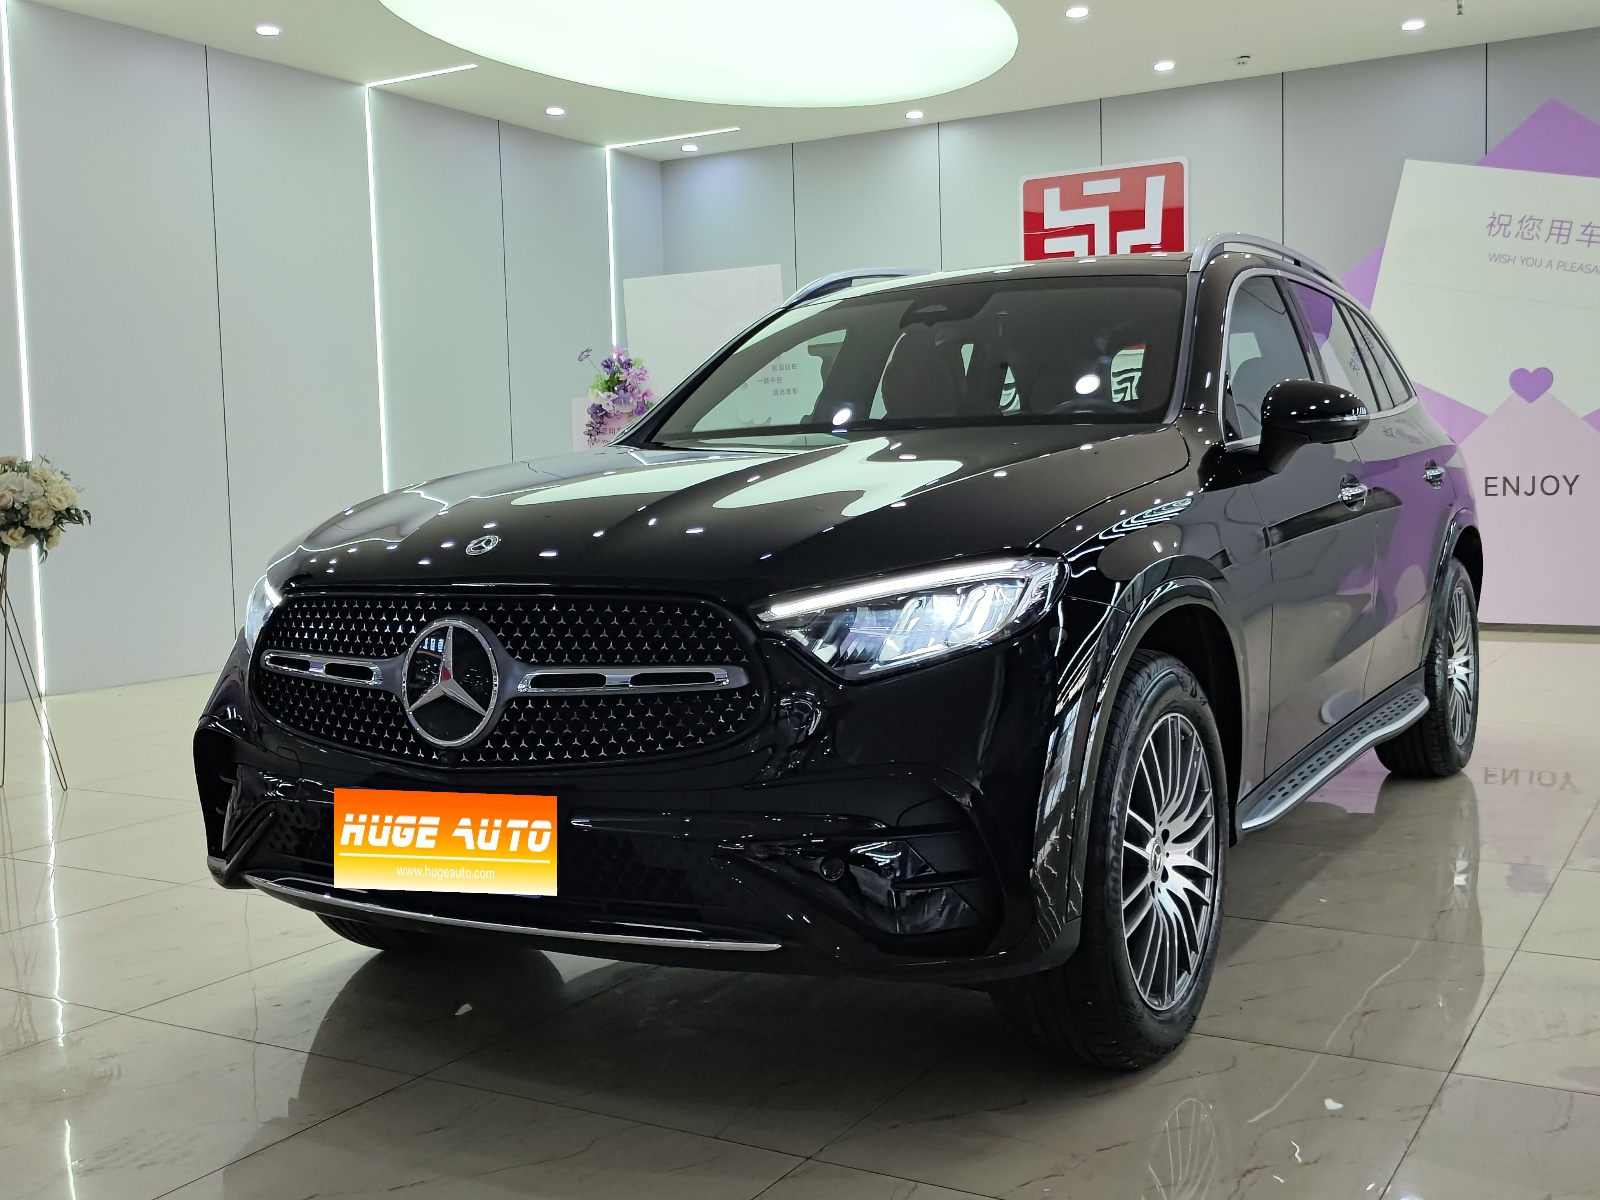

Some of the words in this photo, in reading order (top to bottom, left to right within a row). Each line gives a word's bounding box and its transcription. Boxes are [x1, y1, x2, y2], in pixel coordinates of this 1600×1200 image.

[1488, 252, 1516, 265] WISH
[1520, 256, 1543, 268] YOU
[1545, 259, 1553, 270] A
[1556, 261, 1600, 275] PLEASA
[1484, 474, 1580, 497] ENJOY
